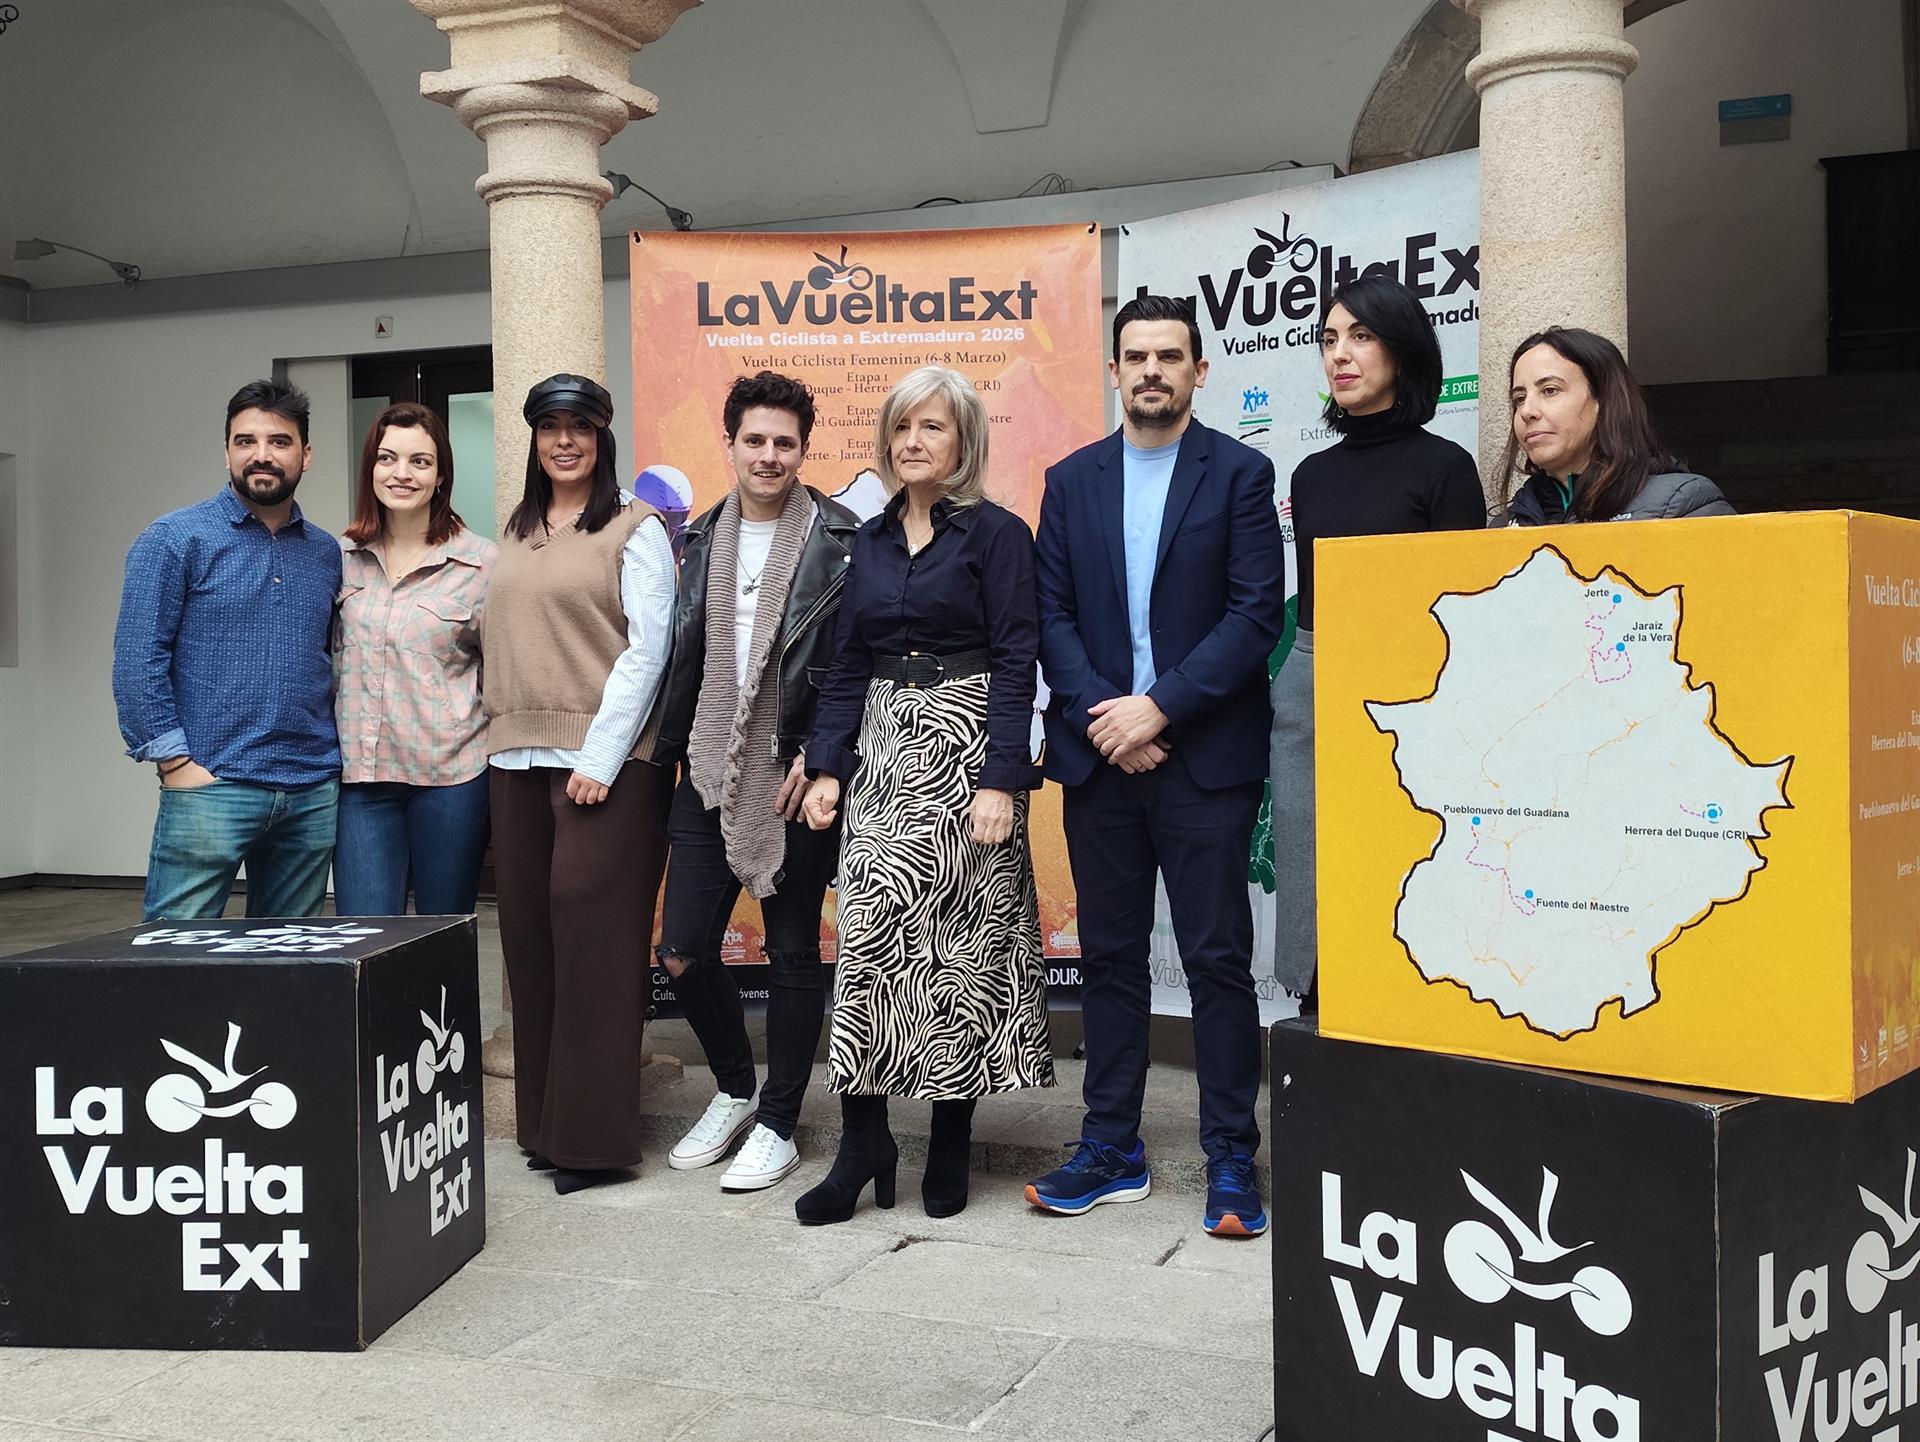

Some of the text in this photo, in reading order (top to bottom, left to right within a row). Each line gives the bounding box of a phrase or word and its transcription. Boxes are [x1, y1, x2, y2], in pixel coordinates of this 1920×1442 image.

[697, 275, 1038, 327] LaVueltaExt
[705, 327, 1025, 348] Vuelta Ciclista a Extremadura 2026
[1222, 331, 1280, 356] Vuelta
[1285, 324, 1323, 347] Cicli
[742, 351, 1007, 368] Vuelta Ciclista Femenina (6-8 Marzo)
[847, 372, 880, 385] Etapa
[1584, 588, 1610, 597] Jerte
[1864, 574, 1920, 607] Vuelta Cic
[1622, 633, 1673, 642] de la Vera
[1443, 805, 1570, 818] Pueblonuevo del Guadiana
[1624, 826, 1663, 836] Herrera
[1666, 827, 1682, 837] del
[1684, 828, 1719, 840] Duque
[1536, 898, 1630, 913] Fuente del Maestre
[35, 1066, 124, 1136] La
[376, 1054, 410, 1123] La
[380, 1091, 469, 1193] Vuelta
[42, 1138, 304, 1216] Vuelta
[429, 1156, 472, 1237] Ext
[1321, 1170, 1418, 1286] La
[182, 1222, 310, 1292] Ext
[1758, 1252, 1829, 1357] La
[1329, 1274, 1640, 1442] Vuelta
